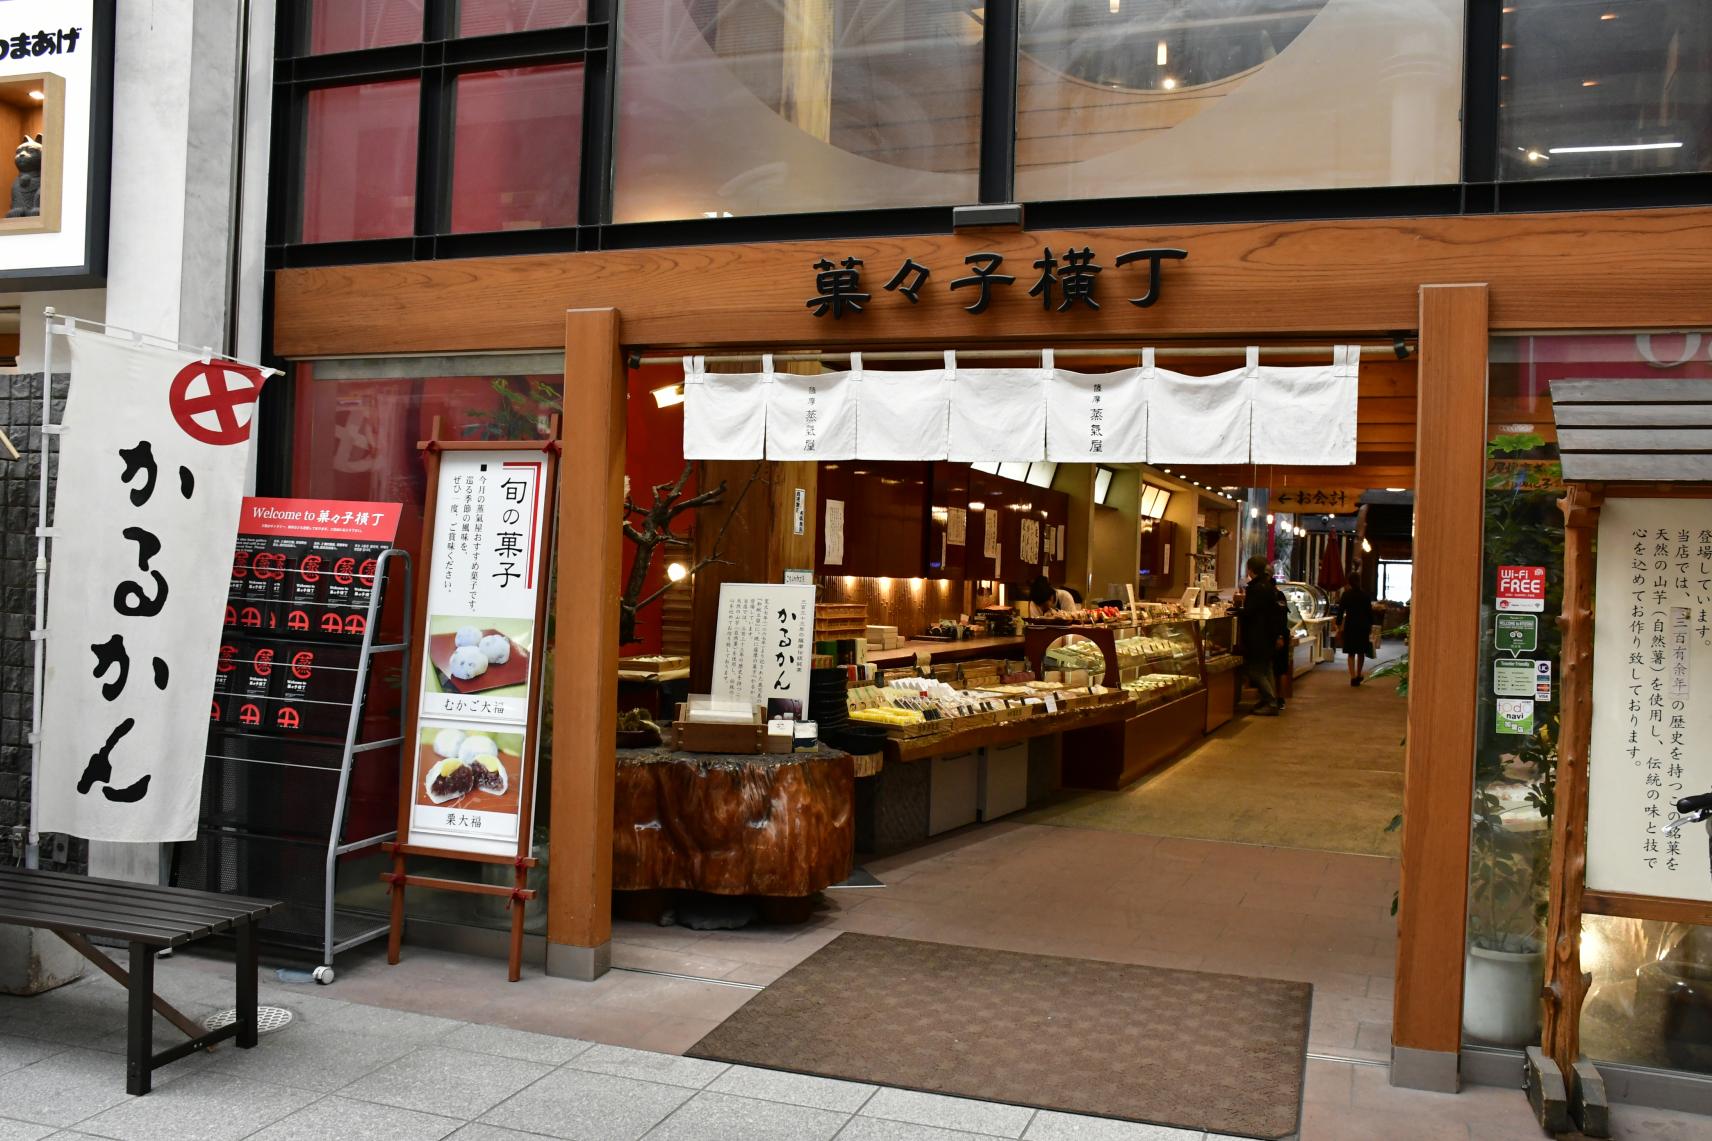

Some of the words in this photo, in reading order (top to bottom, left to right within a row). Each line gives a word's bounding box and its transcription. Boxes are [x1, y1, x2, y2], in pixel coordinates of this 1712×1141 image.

[806, 246, 1188, 320] 菓々子横丁
[1296, 489, 1345, 508] お会計
[252, 506, 302, 521] Welcome
[304, 509, 316, 521] to
[317, 509, 385, 527] 菓々子横丁
[491, 477, 527, 588] 旬の菓子
[1501, 569, 1528, 579] Wi-Fi
[1500, 579, 1541, 593] FREE
[77, 440, 194, 803] かるかん
[774, 608, 797, 690] かるかん
[444, 699, 504, 714] むかご大福
[445, 813, 482, 828] 栗大福
